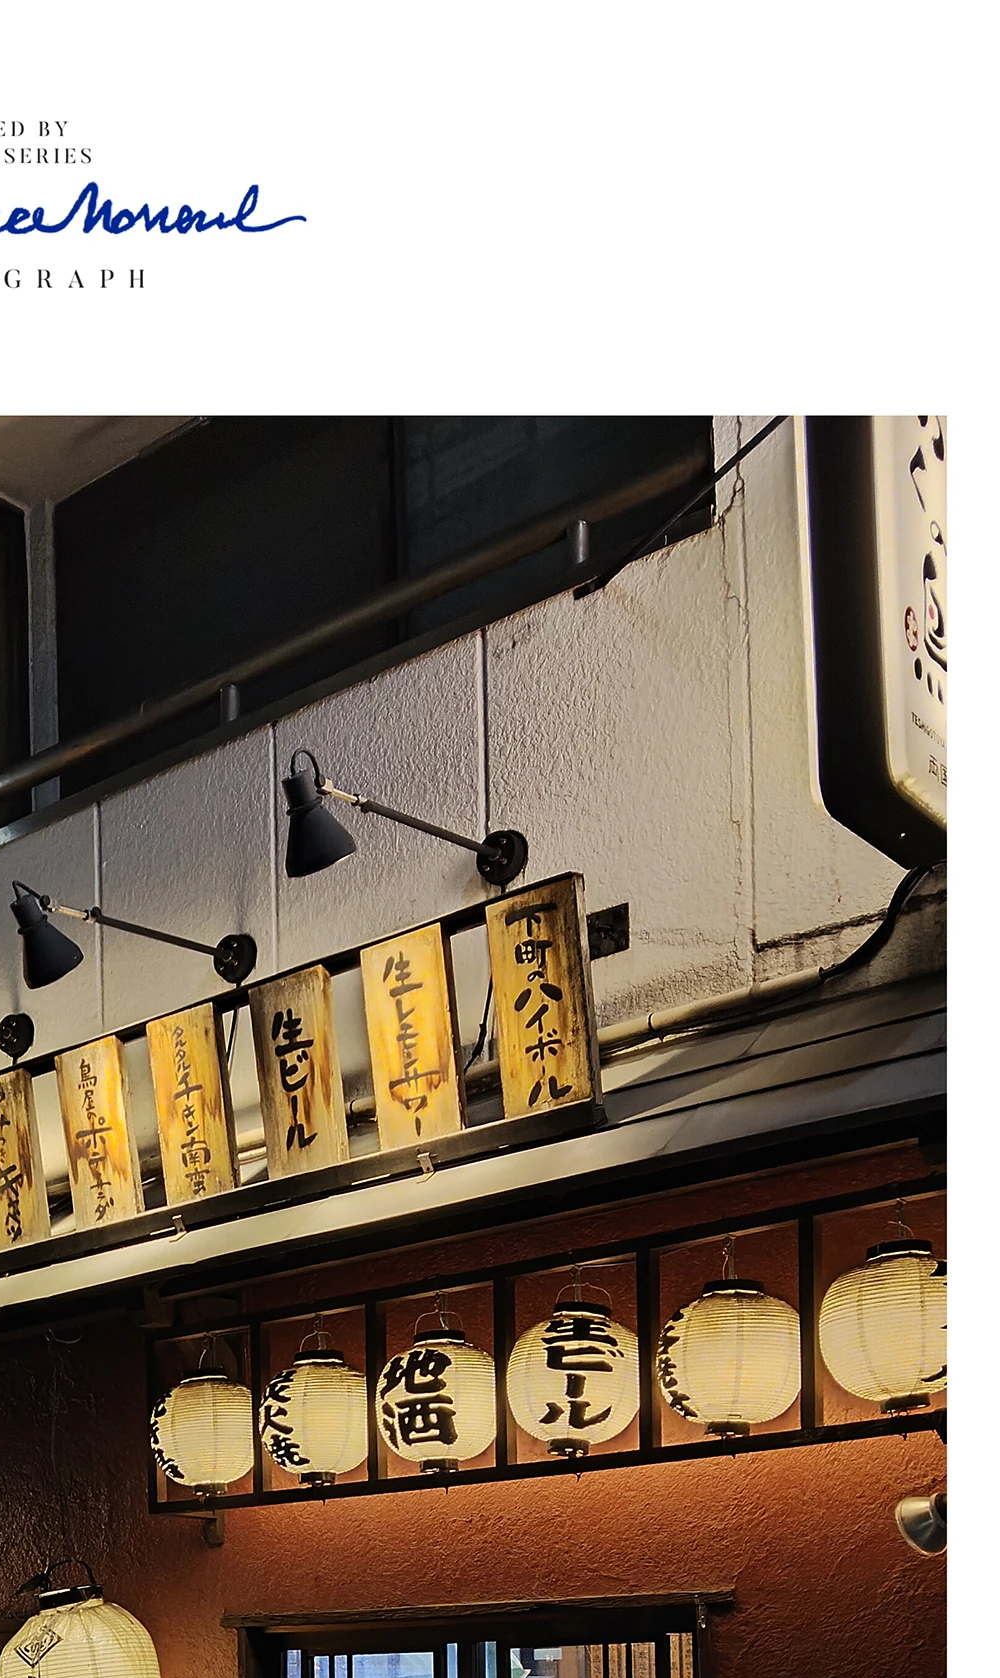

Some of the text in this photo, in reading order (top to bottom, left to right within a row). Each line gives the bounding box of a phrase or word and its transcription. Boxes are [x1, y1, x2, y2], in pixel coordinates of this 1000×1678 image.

[271, 1008, 318, 1151] 生ビール
[383, 951, 441, 1137] 生レモンサワー
[505, 903, 573, 1107] 下町のハイボール
[172, 1025, 211, 1194] タルタルチキン南蛮
[380, 1349, 458, 1450] 地酒
[539, 1318, 625, 1429] 生ビール
